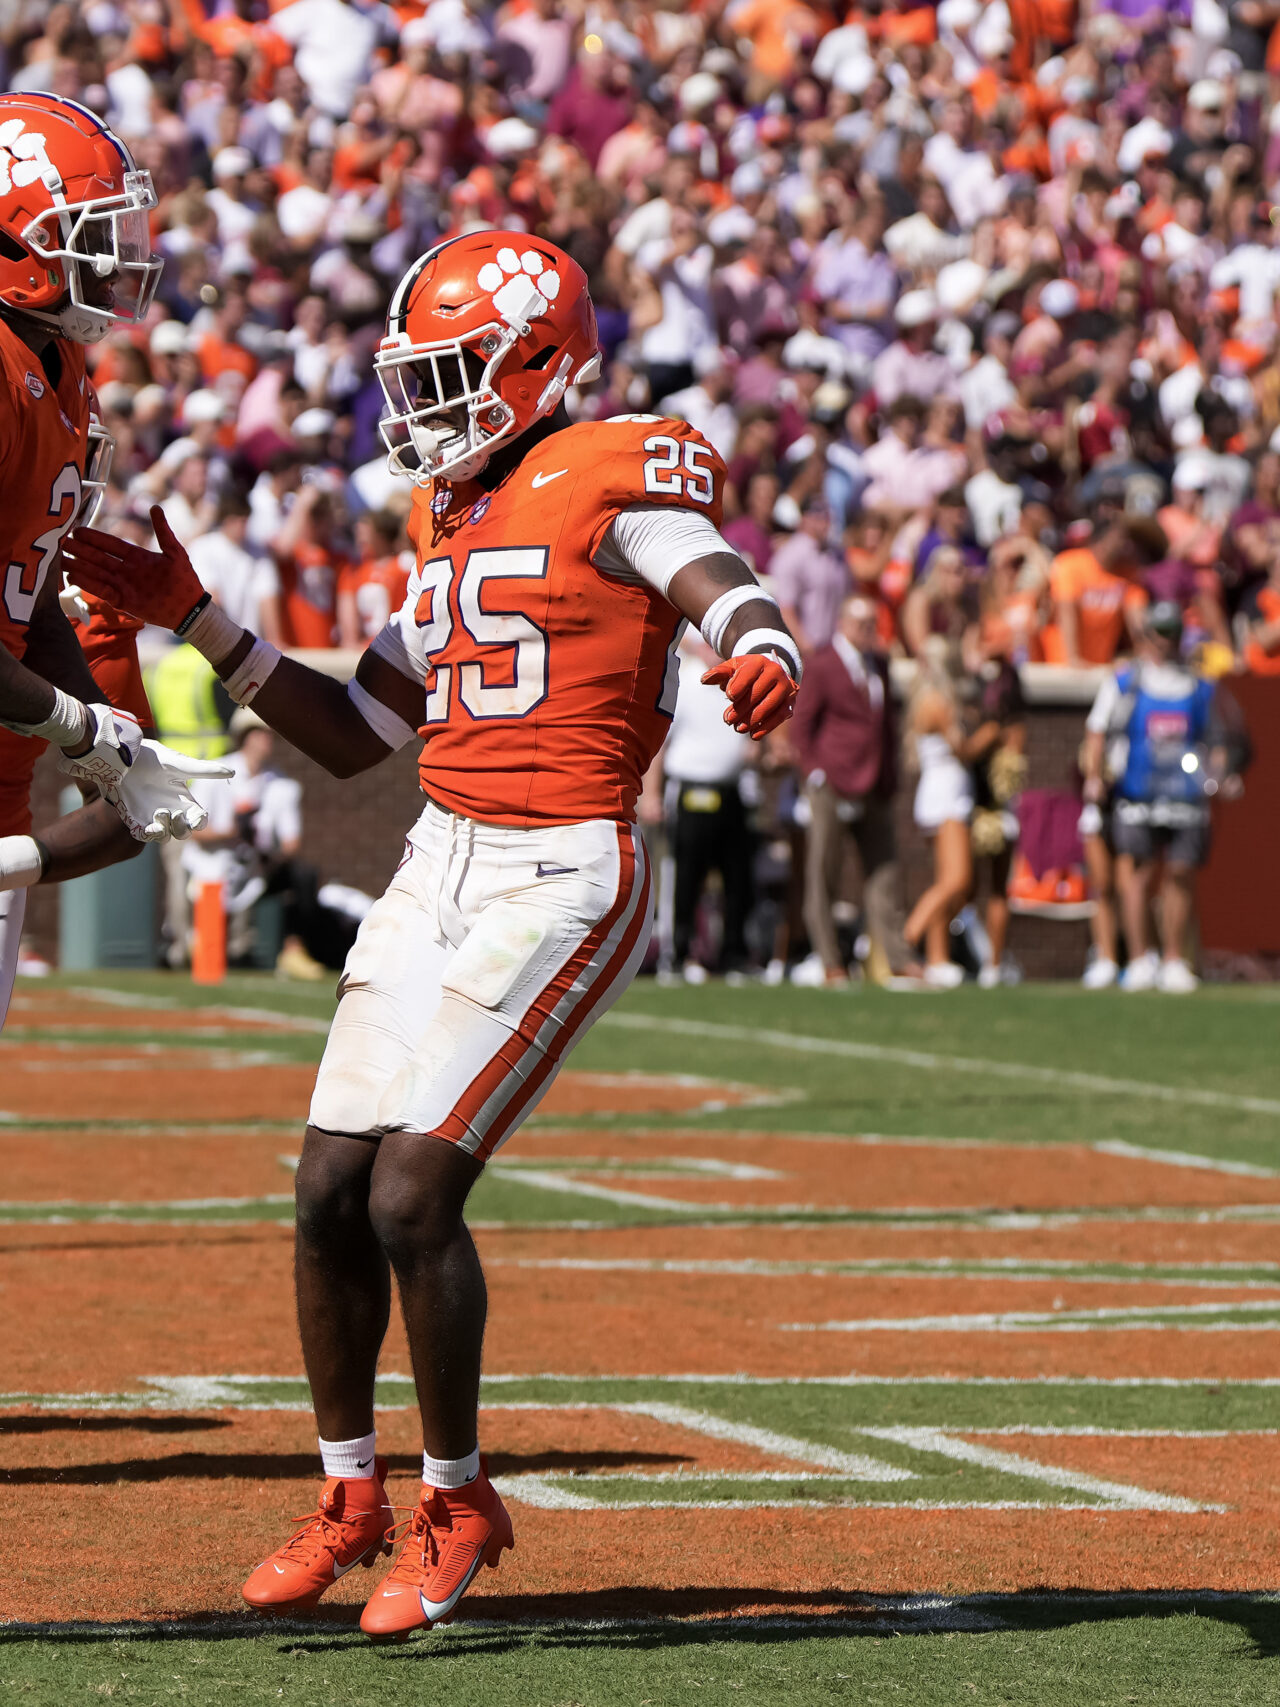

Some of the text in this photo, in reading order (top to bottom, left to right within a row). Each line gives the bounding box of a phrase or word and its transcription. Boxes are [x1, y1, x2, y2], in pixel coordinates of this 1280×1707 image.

[3, 462, 82, 624] 3
[642, 435, 714, 505] 25
[416, 545, 549, 722] 25
